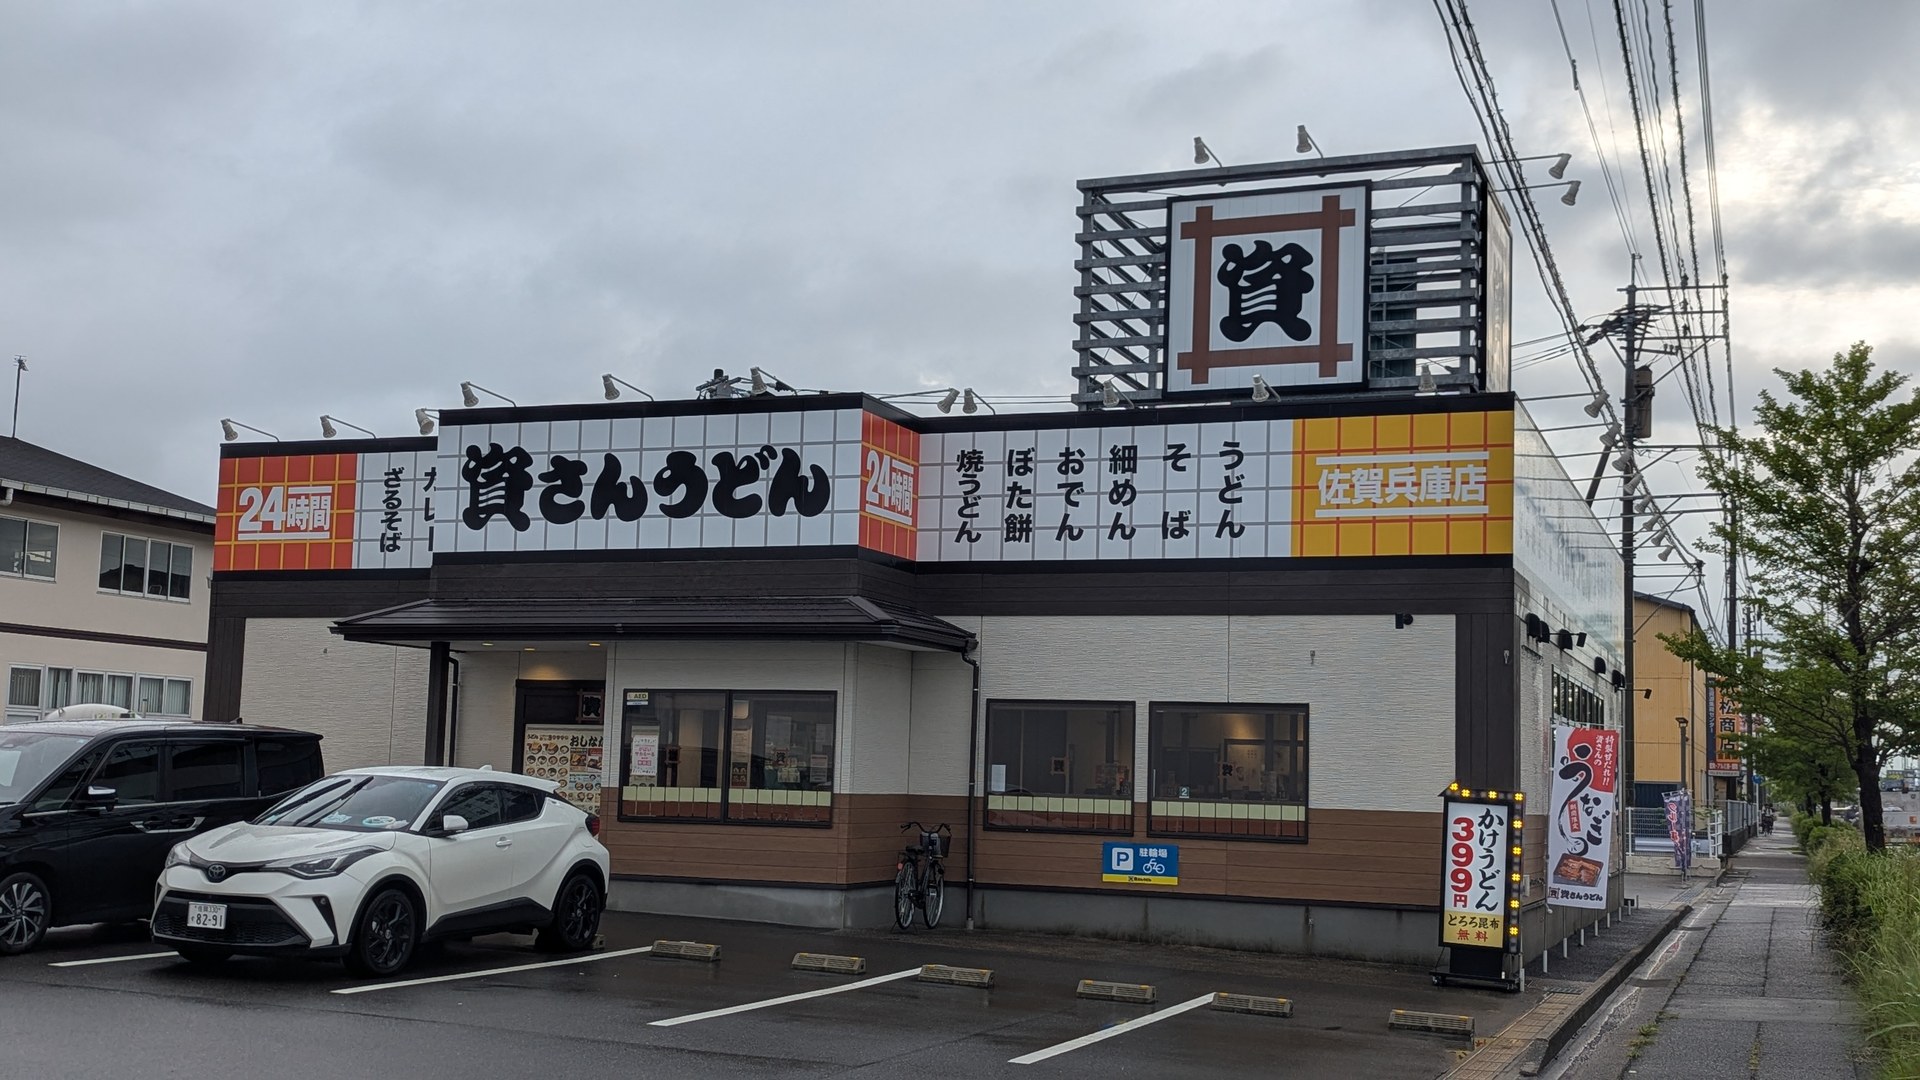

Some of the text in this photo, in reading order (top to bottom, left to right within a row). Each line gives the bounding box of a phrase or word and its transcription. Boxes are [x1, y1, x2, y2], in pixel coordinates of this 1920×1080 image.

[1217, 240, 1314, 342] 資
[238, 487, 331, 532] 24時間
[380, 467, 404, 553] ざるそば
[462, 443, 830, 532] 資さんうどん
[867, 452, 913, 511] 24時間
[955, 448, 984, 544] 焼うどん
[1004, 447, 1035, 544] ぼた餅
[1055, 446, 1085, 542] おでん
[1107, 444, 1138, 541] 細めん
[1162, 443, 1192, 539] そば
[1216, 441, 1246, 539] うどん
[1317, 464, 1488, 506] 佐賀兵庫店
[1181, 788, 1188, 797] 2
[1558, 744, 1611, 856] うなぎ
[1117, 852, 1129, 866] P
[1450, 817, 1475, 908] 399円
[1475, 808, 1504, 912] かけうどん
[196, 913, 222, 926] 82-91
[1447, 914, 1500, 930] とろろ昆布
[1456, 929, 1489, 942] 無料
